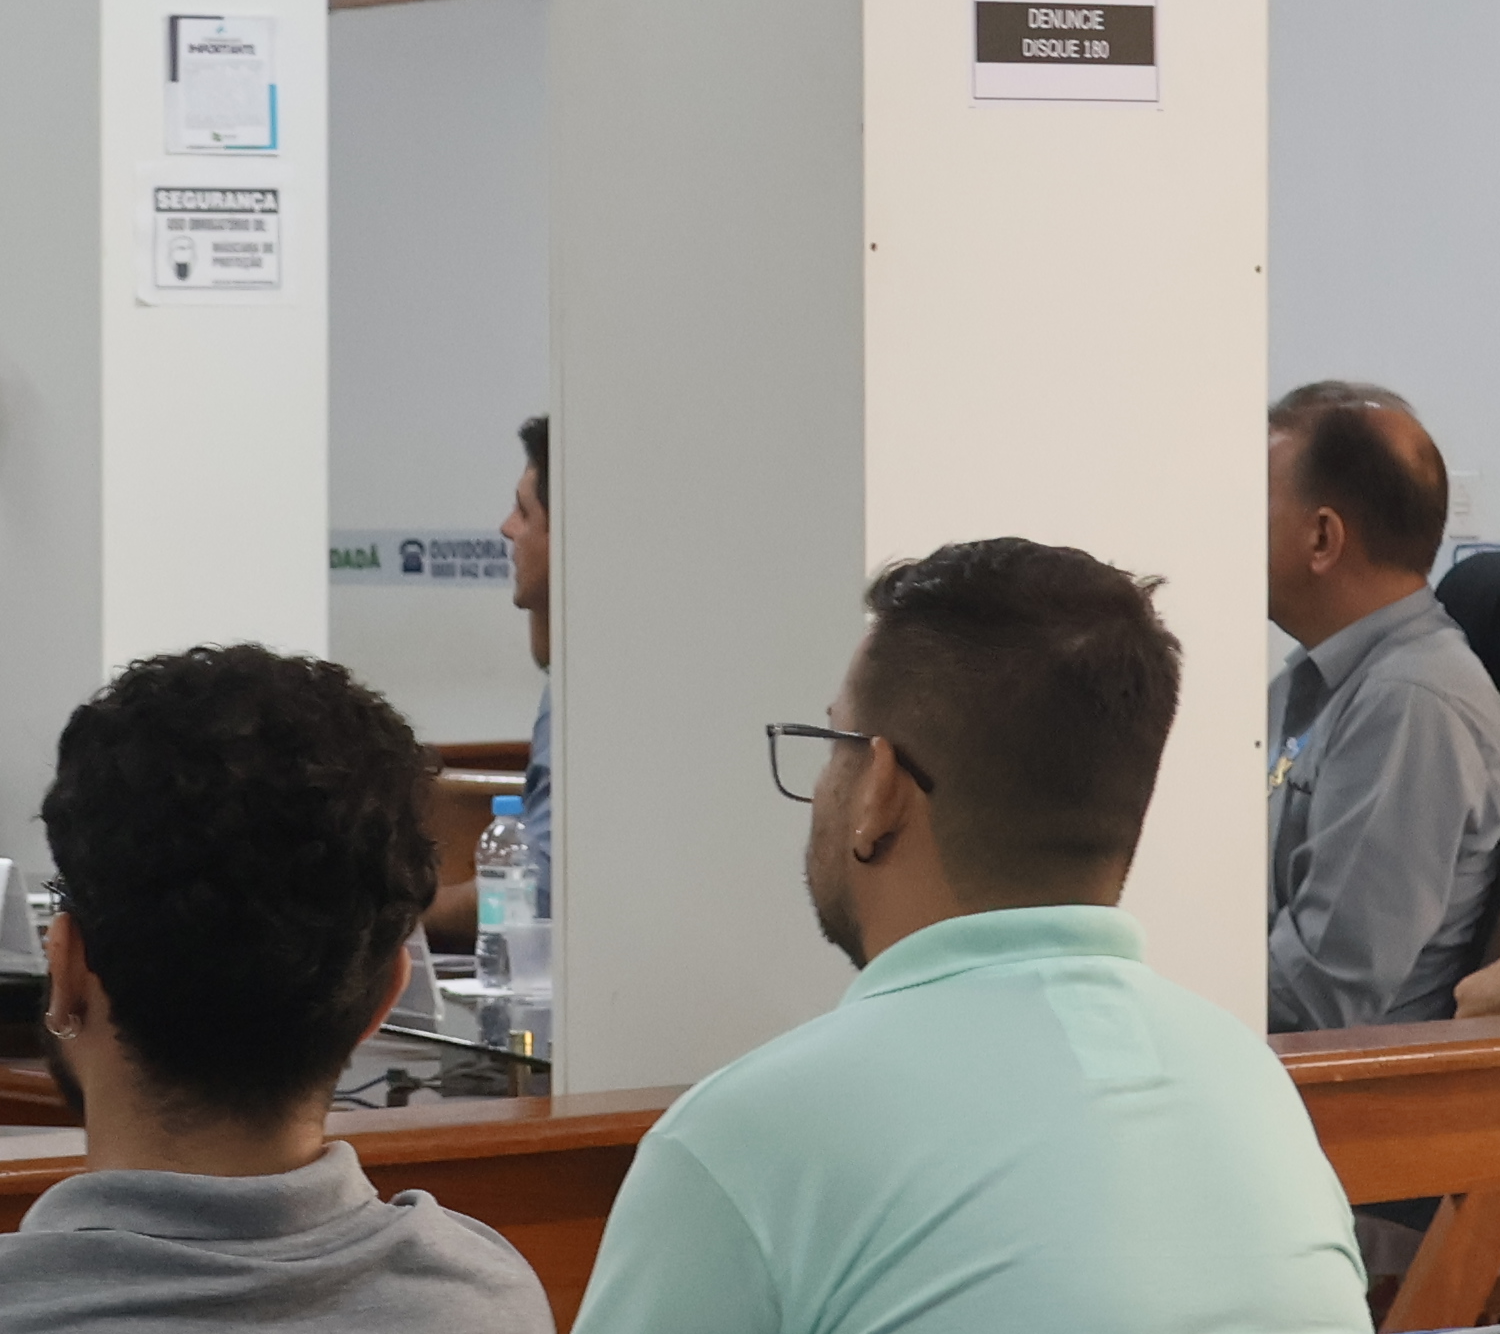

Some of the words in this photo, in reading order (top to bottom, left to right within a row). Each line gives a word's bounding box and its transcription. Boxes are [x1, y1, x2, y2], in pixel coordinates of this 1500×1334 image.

[1028, 8, 1105, 30] DENUNCIE
[1022, 38, 1081, 59] DISQUE
[1083, 40, 1110, 59] 180
[158, 190, 277, 213] SEGURANÇA
